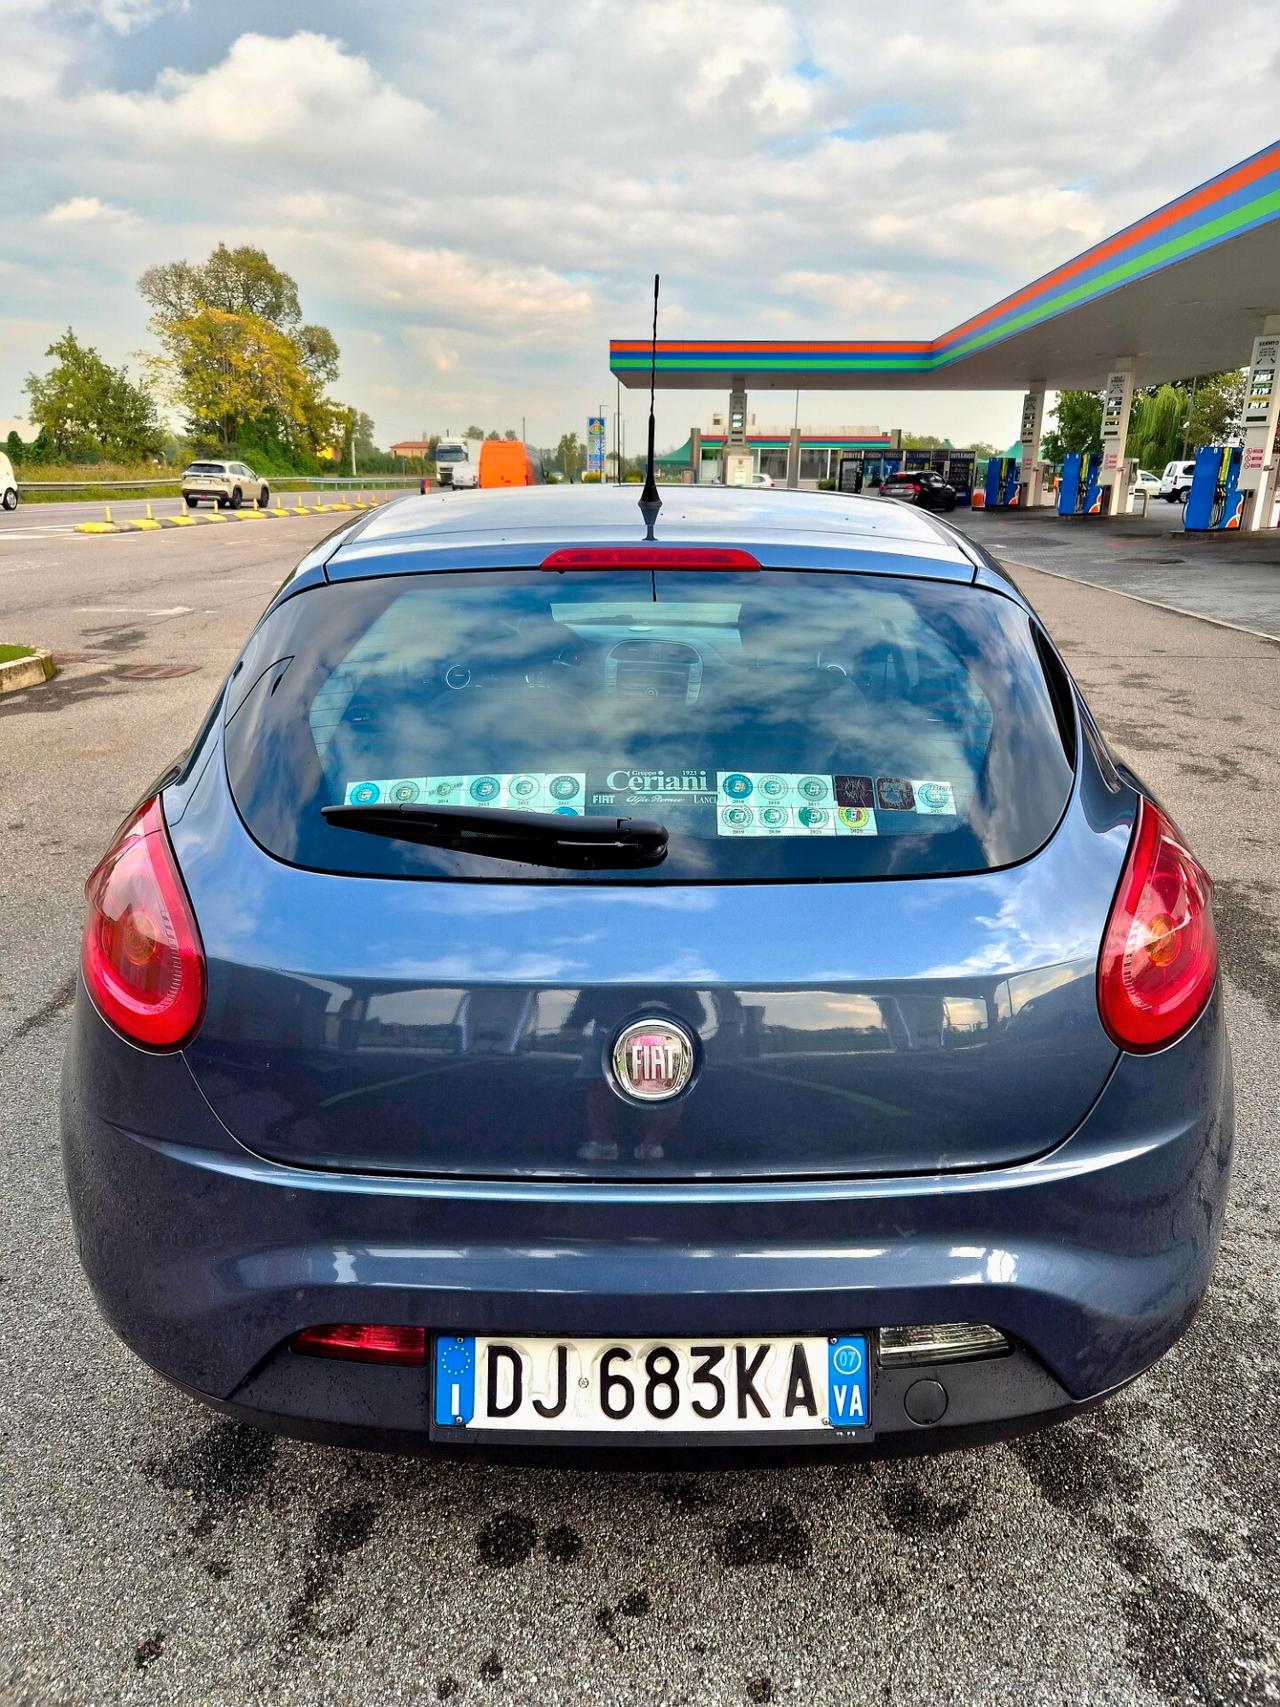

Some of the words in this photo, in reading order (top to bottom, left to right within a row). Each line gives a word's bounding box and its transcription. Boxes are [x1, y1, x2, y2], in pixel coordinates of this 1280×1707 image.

[606, 770, 708, 791] Ceriani
[593, 795, 615, 804] FIAT
[631, 1045, 677, 1080] FIAT
[838, 1351, 857, 1368] 07
[486, 1344, 569, 1420] DJ
[599, 1344, 820, 1420] 683KA
[451, 1383, 460, 1416] I
[834, 1384, 864, 1418] VA
